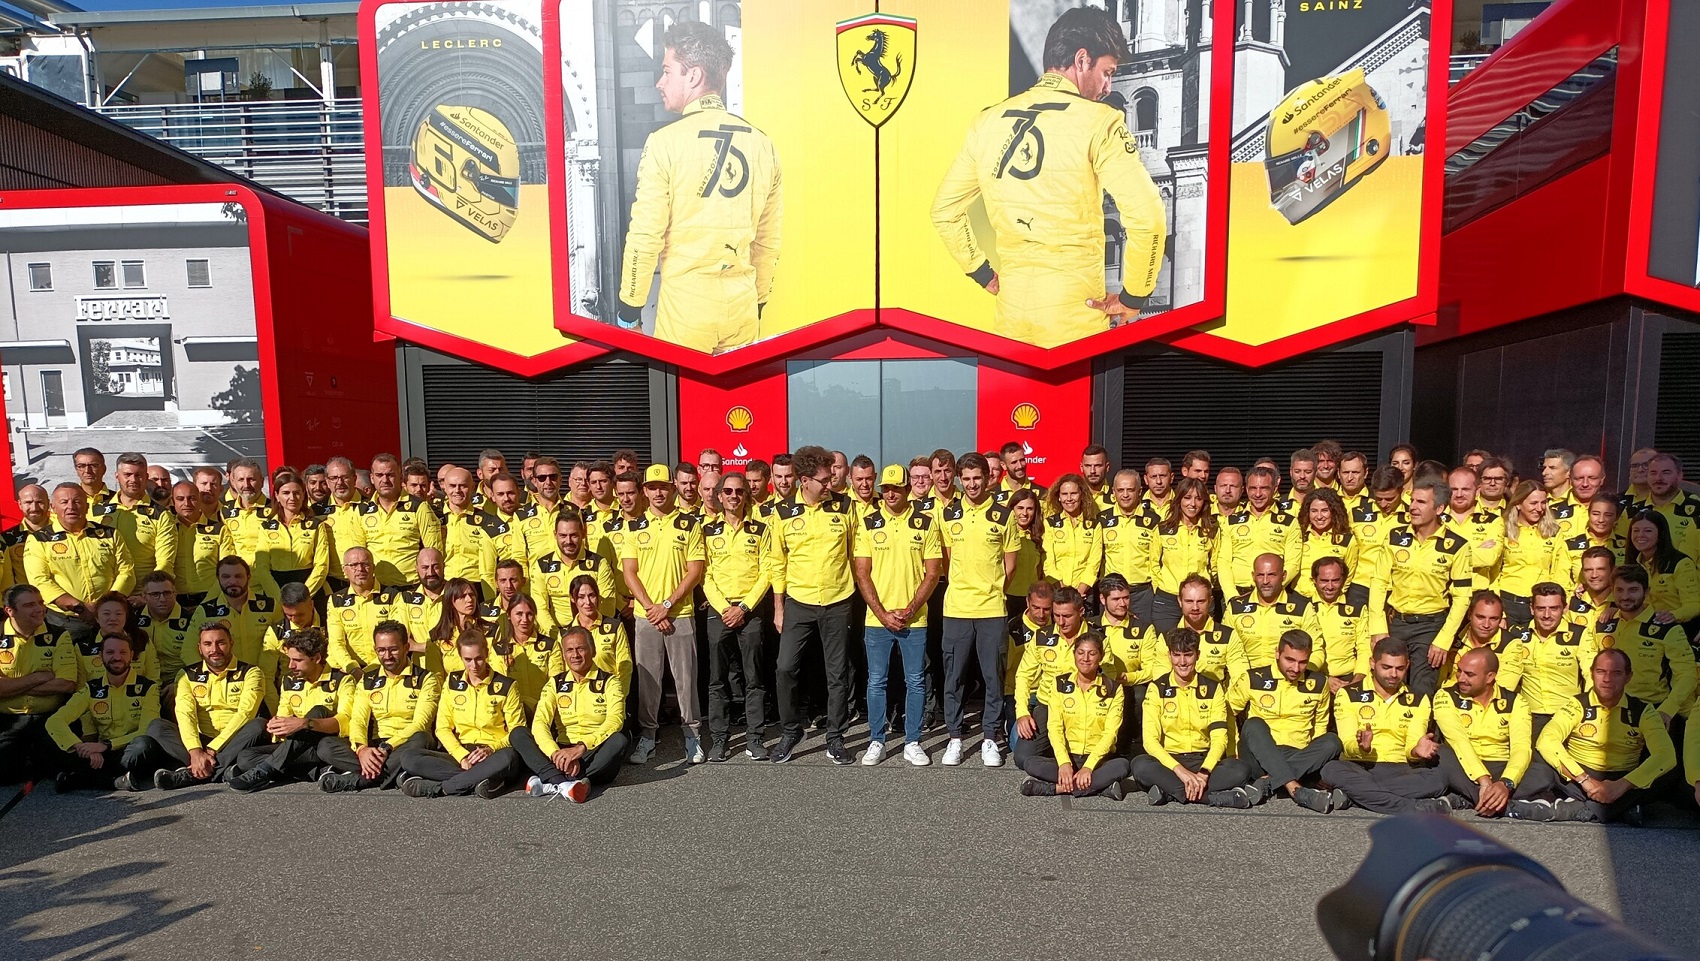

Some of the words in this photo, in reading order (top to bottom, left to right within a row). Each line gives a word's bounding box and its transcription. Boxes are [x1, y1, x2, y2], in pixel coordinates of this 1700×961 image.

[1299, 0, 1363, 12] SAINZ
[421, 38, 502, 49] LECLERC
[1295, 77, 1343, 116] Santander
[459, 117, 504, 150] Santander
[994, 102, 1071, 180] 75
[698, 124, 752, 198] 75
[1305, 163, 1343, 193] VELAS
[467, 207, 500, 231] VELAS
[74, 293, 170, 321] Ferrari
